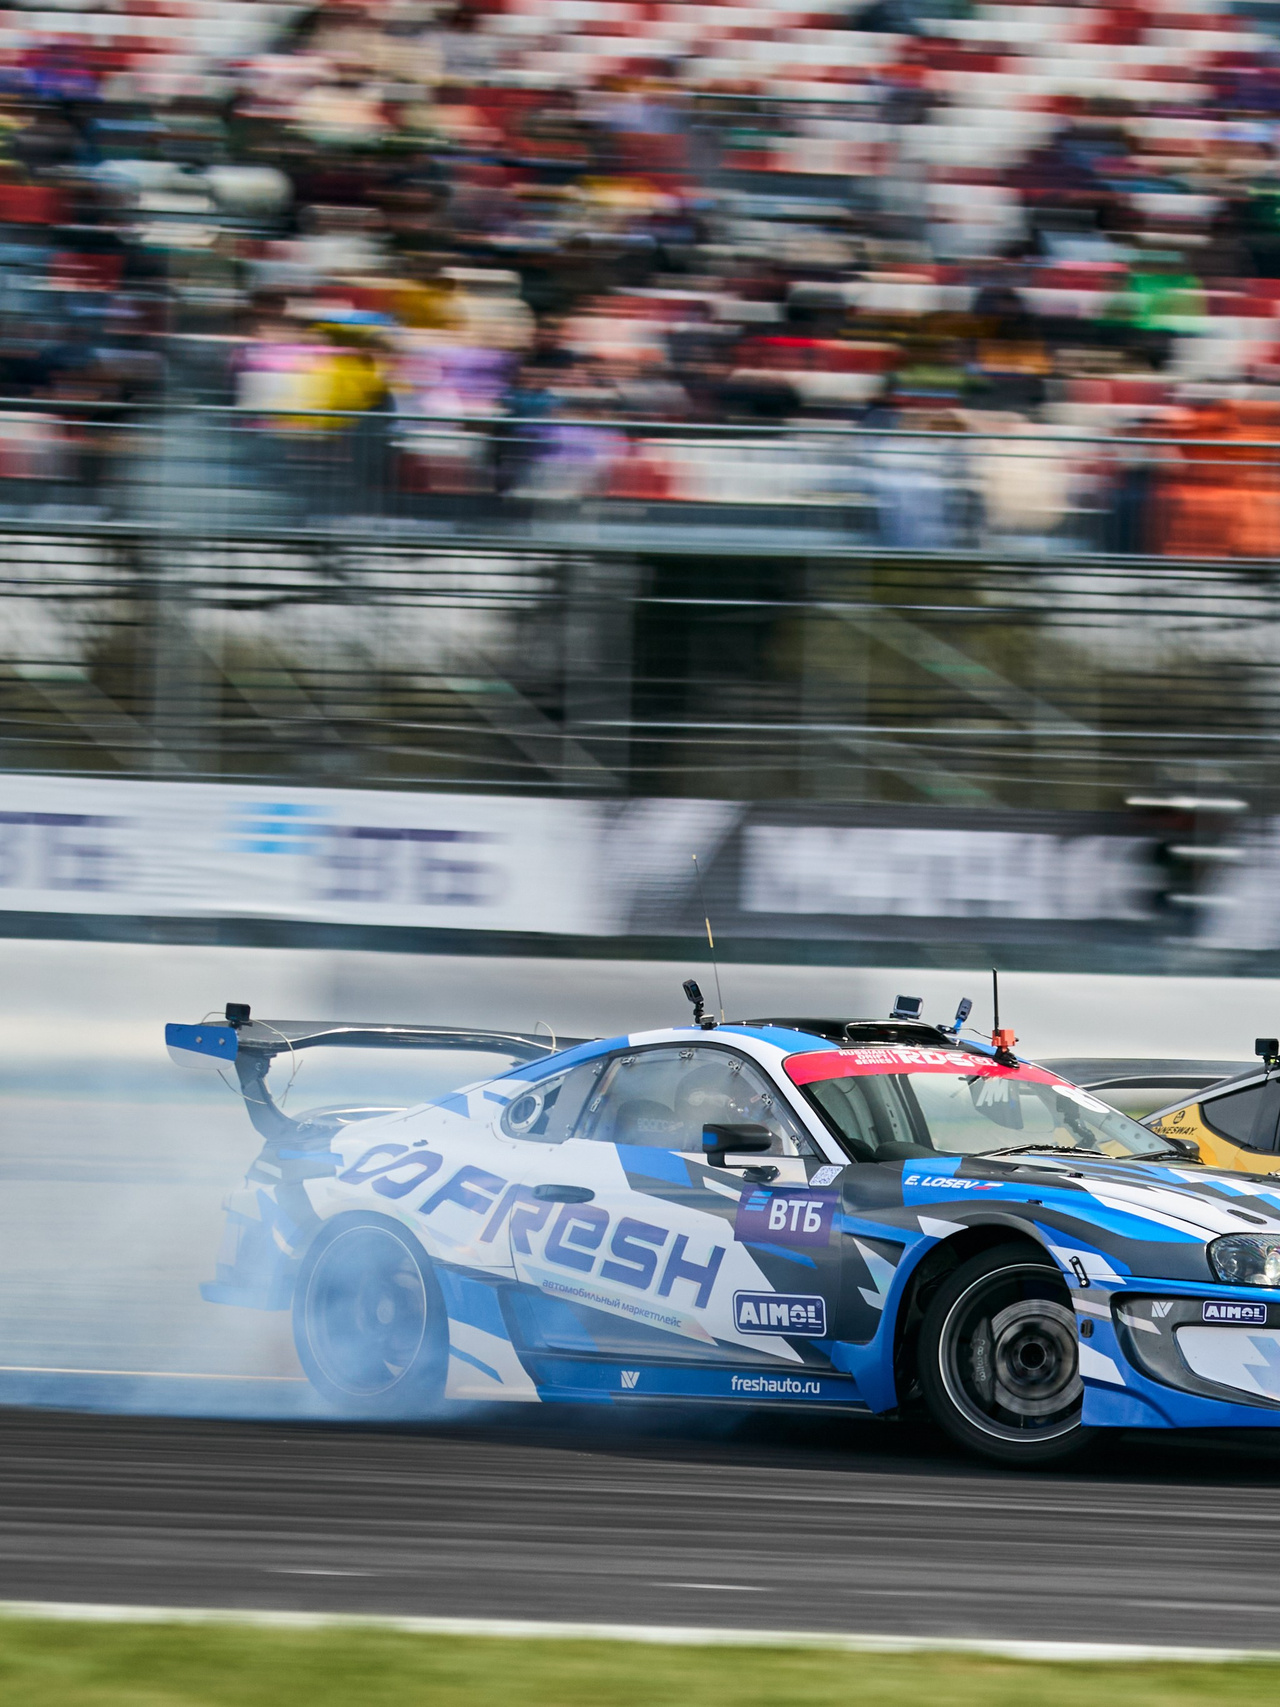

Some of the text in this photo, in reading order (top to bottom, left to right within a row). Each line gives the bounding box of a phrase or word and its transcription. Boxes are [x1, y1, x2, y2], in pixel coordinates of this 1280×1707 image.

[894, 1051, 975, 1067] RDS
[904, 1175, 980, 1190] E. LOSEV
[768, 1198, 824, 1233] ВТБ
[542, 1278, 683, 1328] автомобильный маркетплейс
[1205, 1305, 1264, 1320] AIMOL
[739, 1301, 823, 1329] AIMOL
[731, 1375, 821, 1394] freshauto.ru
